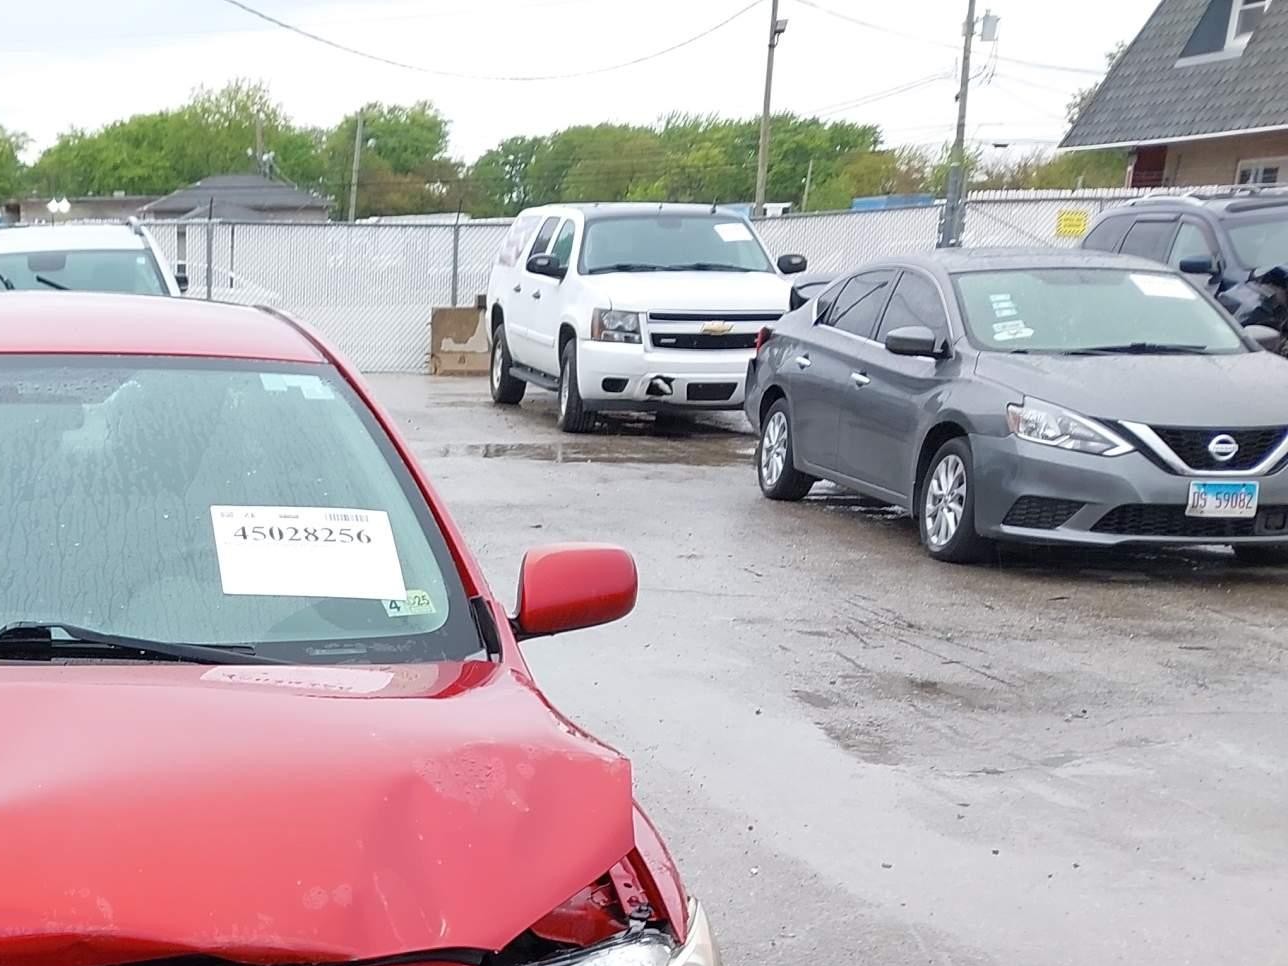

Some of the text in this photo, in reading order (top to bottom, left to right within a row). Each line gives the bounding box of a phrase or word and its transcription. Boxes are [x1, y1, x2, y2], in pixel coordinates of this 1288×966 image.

[1191, 491, 1208, 510] DS
[233, 525, 372, 544] 45028256
[389, 600, 401, 612] 4
